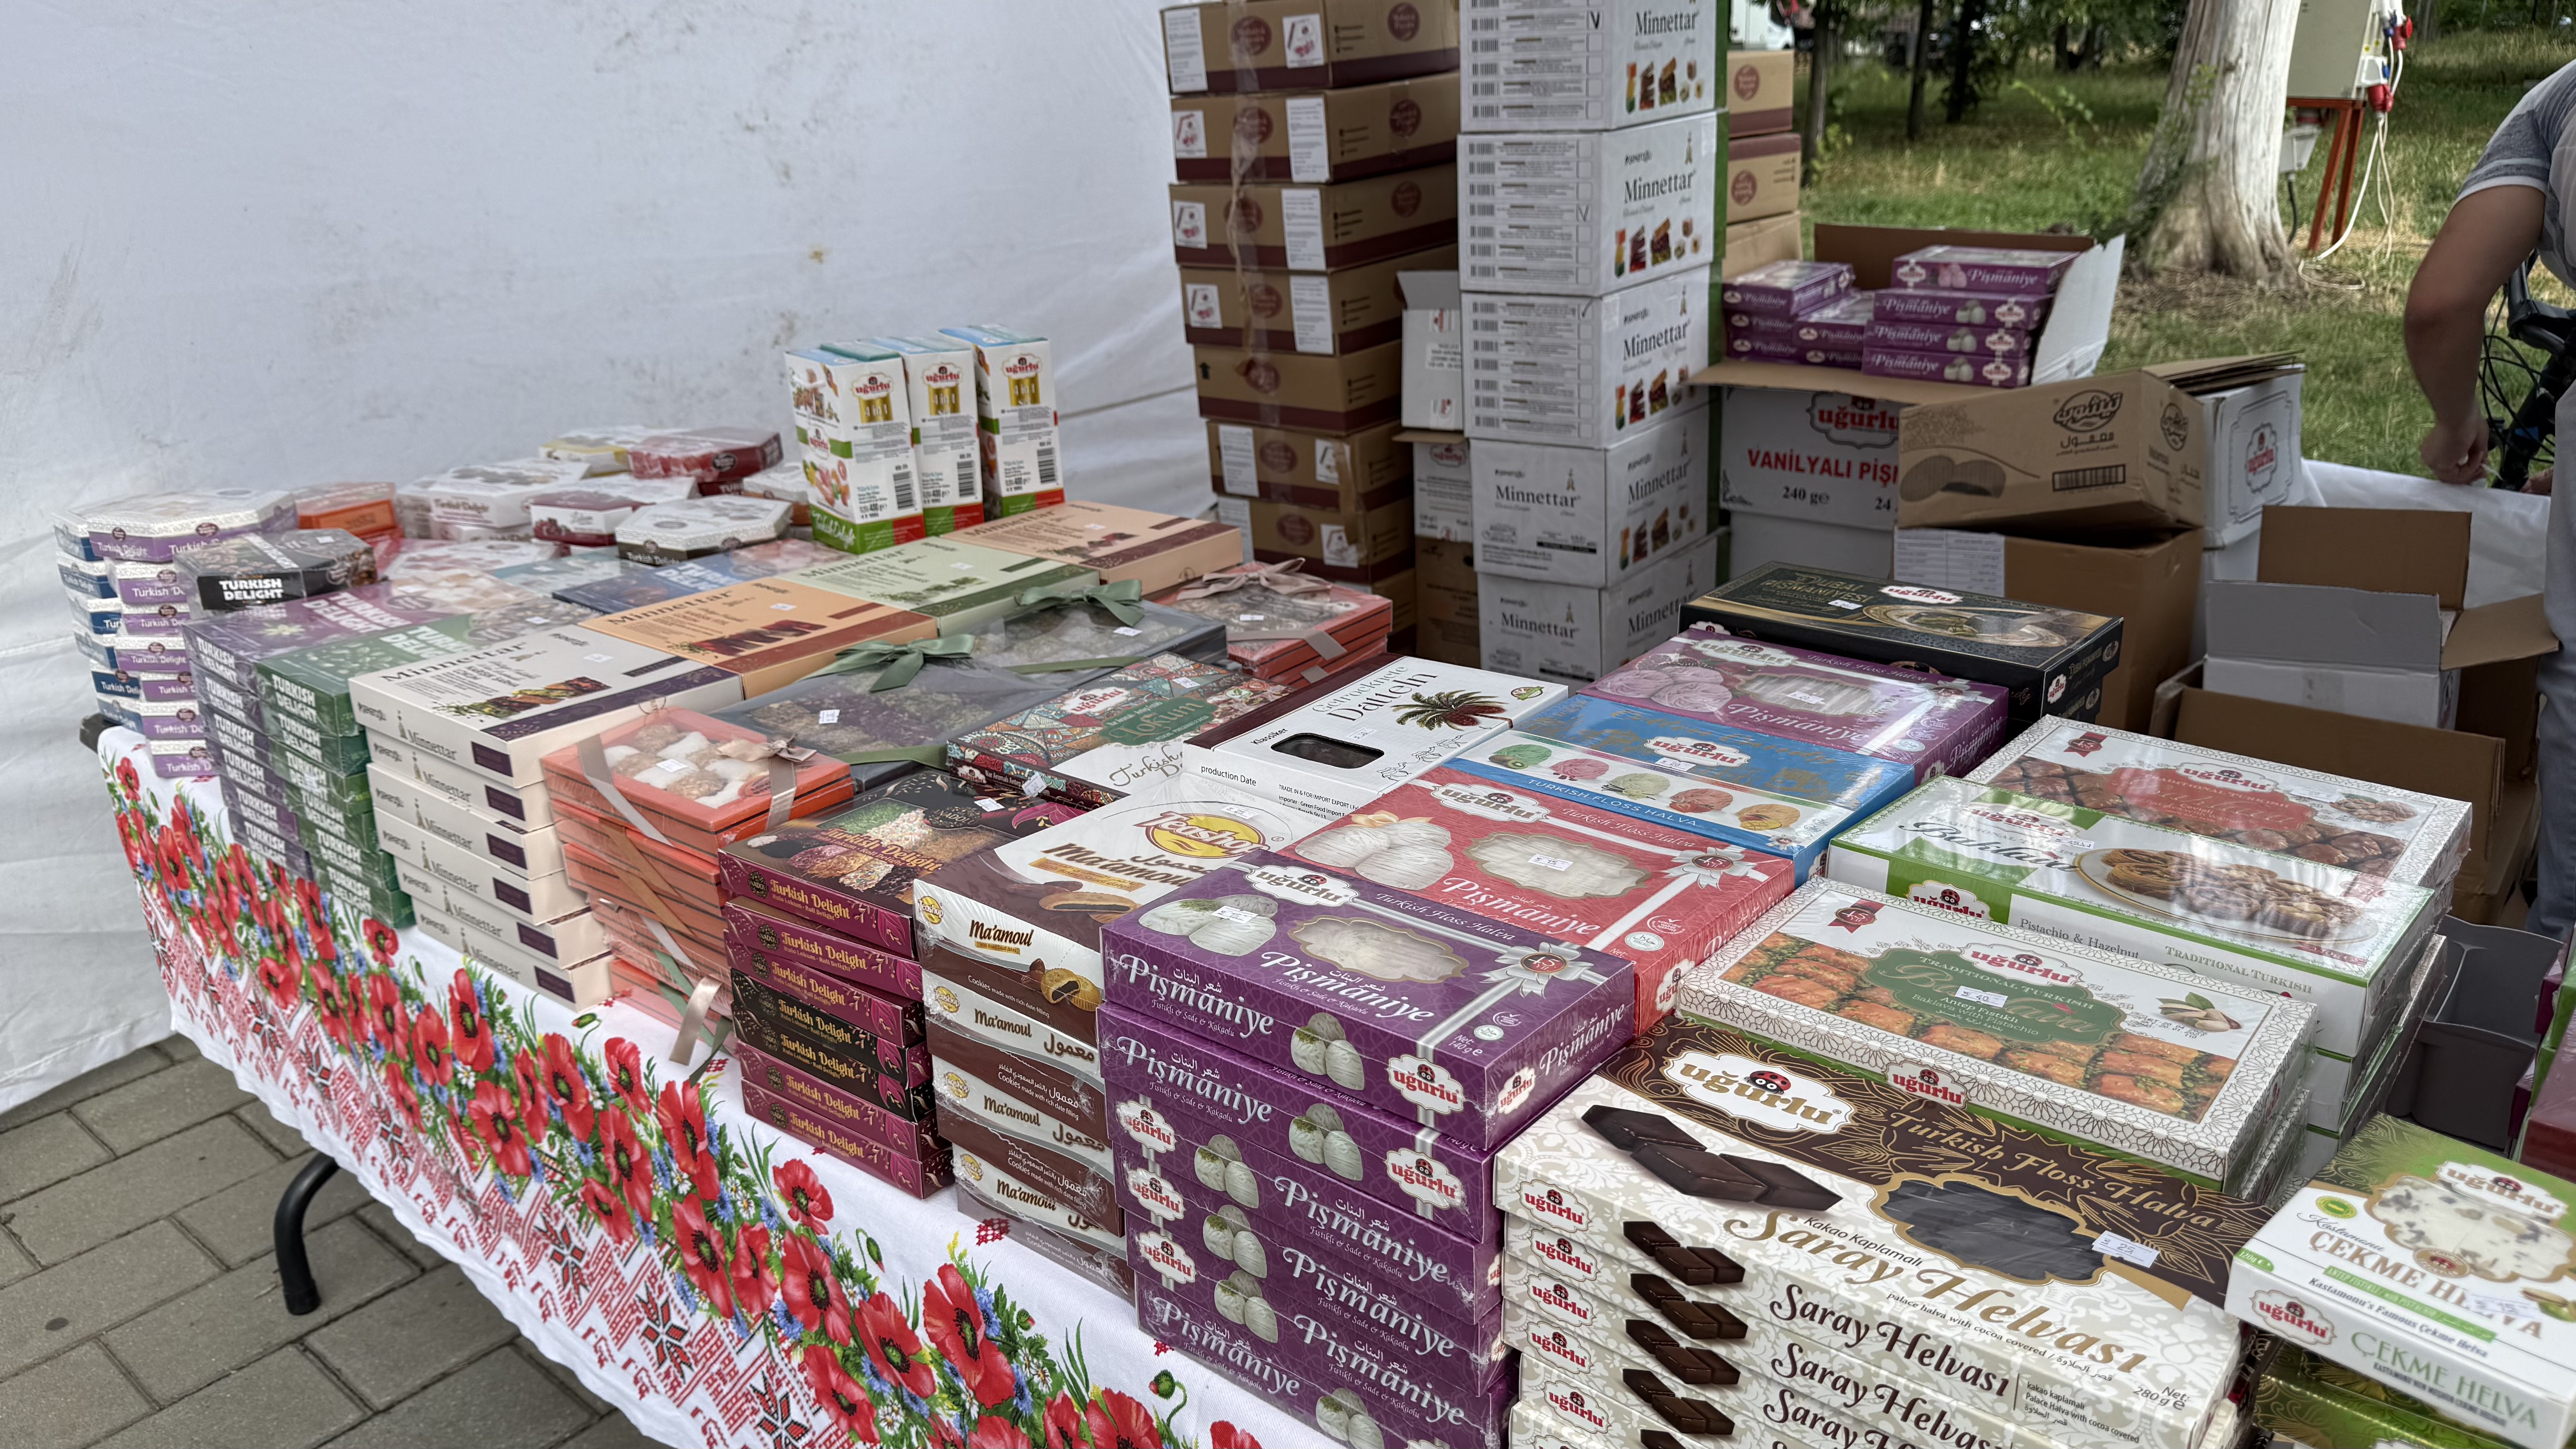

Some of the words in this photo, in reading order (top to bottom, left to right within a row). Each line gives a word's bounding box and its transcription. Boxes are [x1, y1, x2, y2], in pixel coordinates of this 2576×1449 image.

[1635, 10, 1698, 36] Minnettar
[1624, 172, 1692, 203] Minnettar
[1624, 321, 1688, 360] Minnettar
[1748, 449, 1851, 481] VANİLYALI
[1858, 462, 1898, 488] PİŞ
[1495, 485, 1577, 508] Minnettar
[1783, 487, 1806, 500] 240
[1875, 498, 1891, 511] 24
[963, 509, 1056, 537] Minnettar
[220, 578, 282, 591] TURKISH
[224, 589, 283, 600] DELIGHT
[607, 590, 732, 625] Minnettar
[1501, 612, 1575, 639] Minnettar
[382, 643, 527, 681] Minnettar
[272, 675, 315, 707] TURKISH
[1312, 664, 1409, 714] Getrocknete
[1327, 673, 1438, 722] Datteln
[276, 692, 316, 722] DELIGHT
[214, 714, 254, 745] TURKISH
[408, 731, 457, 760] Minnettar
[1250, 728, 1288, 745] Klassiker
[1653, 740, 1739, 765] uğurlu
[1201, 766, 1238, 782] production
[1240, 775, 1256, 786] Date
[1300, 800, 1313, 810] Green
[1314, 804, 1326, 813] Food
[1326, 807, 1342, 817] Import
[1442, 788, 1535, 819] uğurlu
[1528, 778, 1591, 798] TURKISH
[1594, 795, 1640, 812] FLOSS
[1646, 810, 1696, 826] HALVA
[1134, 812, 1269, 855] Teashop
[1562, 809, 1614, 826] Turkish
[1617, 820, 1649, 836] Floss
[1651, 832, 1696, 848] Halva
[821, 828, 879, 850] Turkish
[882, 841, 943, 871] Delight
[1898, 822, 2079, 872] Baklava
[1040, 843, 1194, 887] Ma'amou
[771, 879, 809, 904] Turkish
[812, 894, 850, 919] Delight
[1255, 870, 1345, 902] uğurlu
[1442, 877, 1601, 935] Pişmaniye
[969, 920, 1034, 946] Ma'amoul
[2020, 918, 2069, 941] Pistachio
[2074, 934, 2084, 943] &
[2088, 937, 2139, 959] Hazelnut
[1173, 968, 1200, 986] البنات
[1920, 957, 2019, 989] TRADITIONAL
[2021, 986, 2095, 1010] TURKISH
[1971, 950, 2072, 984] uğurlu
[2165, 946, 2249, 978] TRADITIONAL
[2252, 970, 2313, 994] TURKISH
[968, 975, 990, 990] Cookies
[992, 985, 1005, 997] made
[1005, 992, 1015, 1001] with
[1016, 995, 1025, 1006] rich
[1026, 1001, 1036, 1011] date
[1036, 1005, 1050, 1018] filling
[1119, 953, 1274, 1038] Pişmaniye
[1204, 981, 1222, 994] شعر
[1940, 996, 1976, 1011] Antep
[974, 1008, 1032, 1037] Ma'amoul
[1183, 1012, 1198, 1023] Sade
[1207, 1020, 1235, 1037] Kakaolu
[1912, 994, 1957, 1011] Baklava
[1959, 1006, 1985, 1018] with
[1987, 1014, 2039, 1035] Pistachio
[1044, 1034, 1095, 1062] معمول
[1540, 1004, 1625, 1076] Pişmaniye
[1394, 1068, 1459, 1104] uğurlu
[1680, 1062, 1835, 1126] uğurlu
[1893, 1071, 1962, 1105] uğurlu
[1890, 1112, 2005, 1161] Turkish
[2015, 1152, 2096, 1192] Floss
[2105, 1173, 2222, 1230] Halva
[1525, 1192, 1583, 1225] uğurlu
[1804, 1218, 1848, 1238] Kakao
[1849, 1234, 1923, 1267] Kaplamalı
[2296, 1213, 2385, 1251] Kastamonu
[2309, 1231, 2426, 1288] ÇEKME
[1723, 1210, 1904, 1284] Saray
[1916, 1269, 2146, 1373] Helvası
[1887, 1293, 1918, 1308] palace
[1920, 1304, 1946, 1320] halva
[1950, 1315, 1972, 1328] with
[1974, 1326, 2003, 1342] cocoa
[2006, 1337, 2047, 1357] covered
[2259, 1300, 2328, 1339] uğurlu
[2309, 1278, 2374, 1310] Kastamonu's
[2375, 1305, 2417, 1328] Famous
[2456, 1340, 2487, 1357] Helva
[2027, 1381, 2048, 1397] kakao
[2049, 1389, 2085, 1410] kaplamalı
[2162, 1386, 2190, 1402] Net:
[2351, 1332, 2449, 1387] ÇEKME
[2456, 1376, 2538, 1431] HELVA
[2025, 1392, 2048, 1408] Palace
[2049, 1402, 2070, 1417] Halva
[2072, 1410, 2087, 1423] with
[2089, 1418, 2109, 1431] cocoa
[2111, 1425, 2139, 1444] covered
